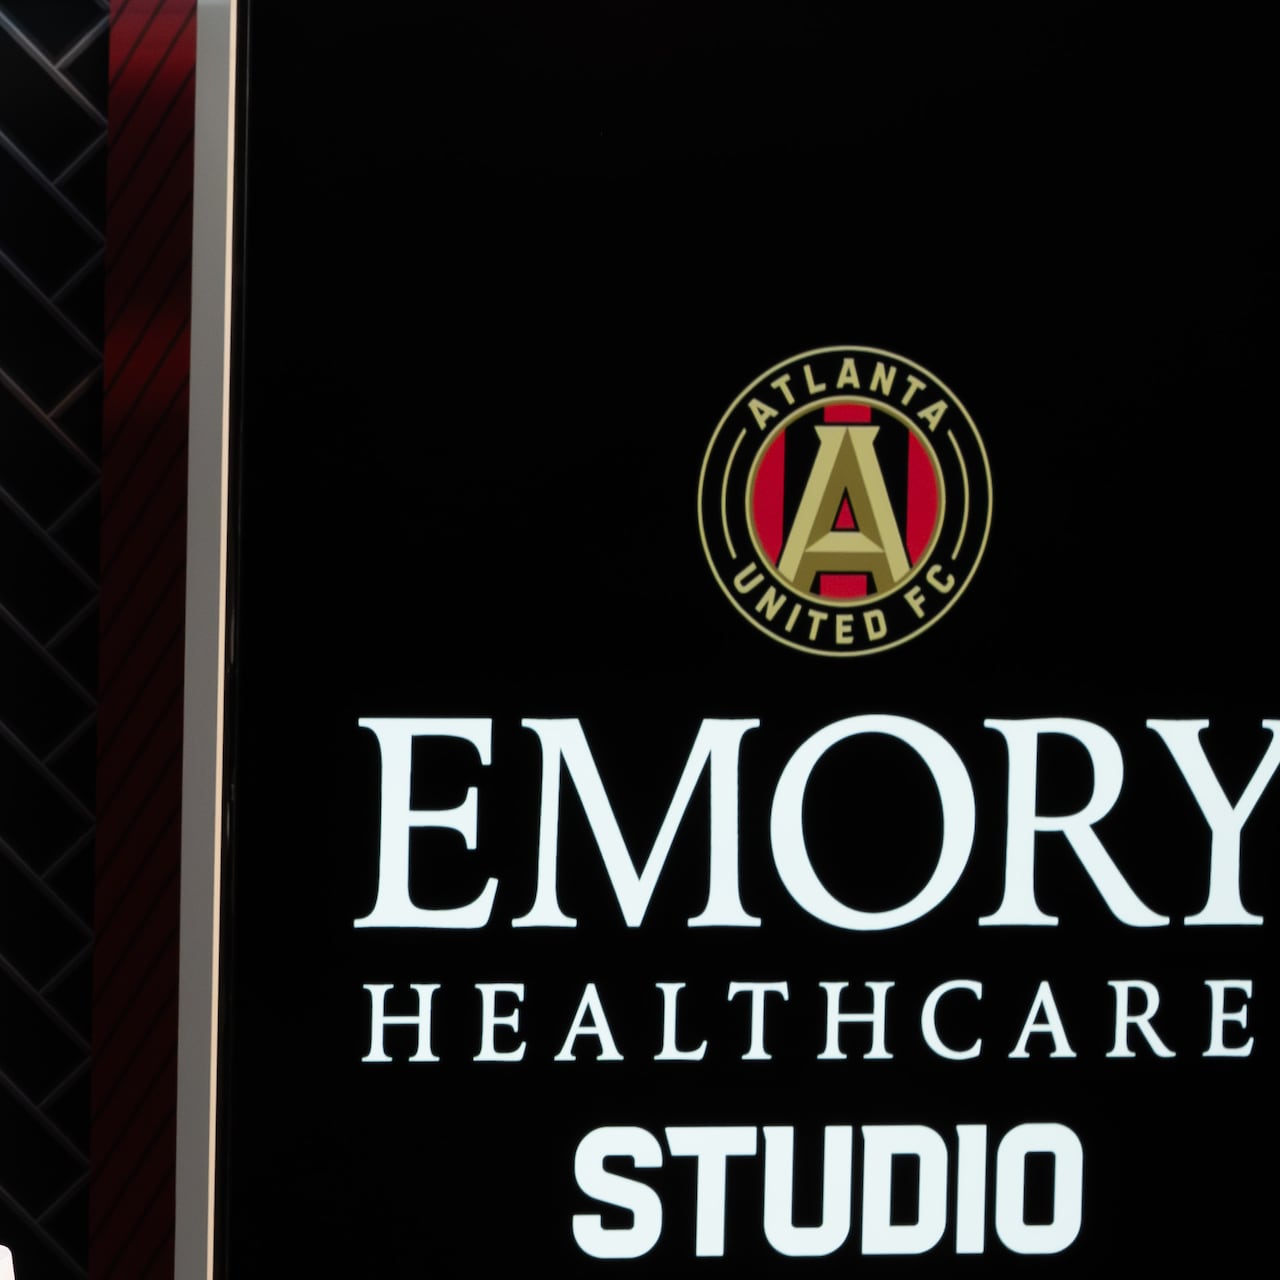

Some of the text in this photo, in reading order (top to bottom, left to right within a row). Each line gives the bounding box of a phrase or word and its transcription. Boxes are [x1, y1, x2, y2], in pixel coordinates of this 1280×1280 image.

[747, 357, 949, 432] ATLANTA
[733, 562, 956, 644] UNITED FC
[353, 714, 1280, 931] EMORY
[362, 979, 1254, 1063] HEALTHCARE
[572, 1122, 1083, 1259] STUDIO
